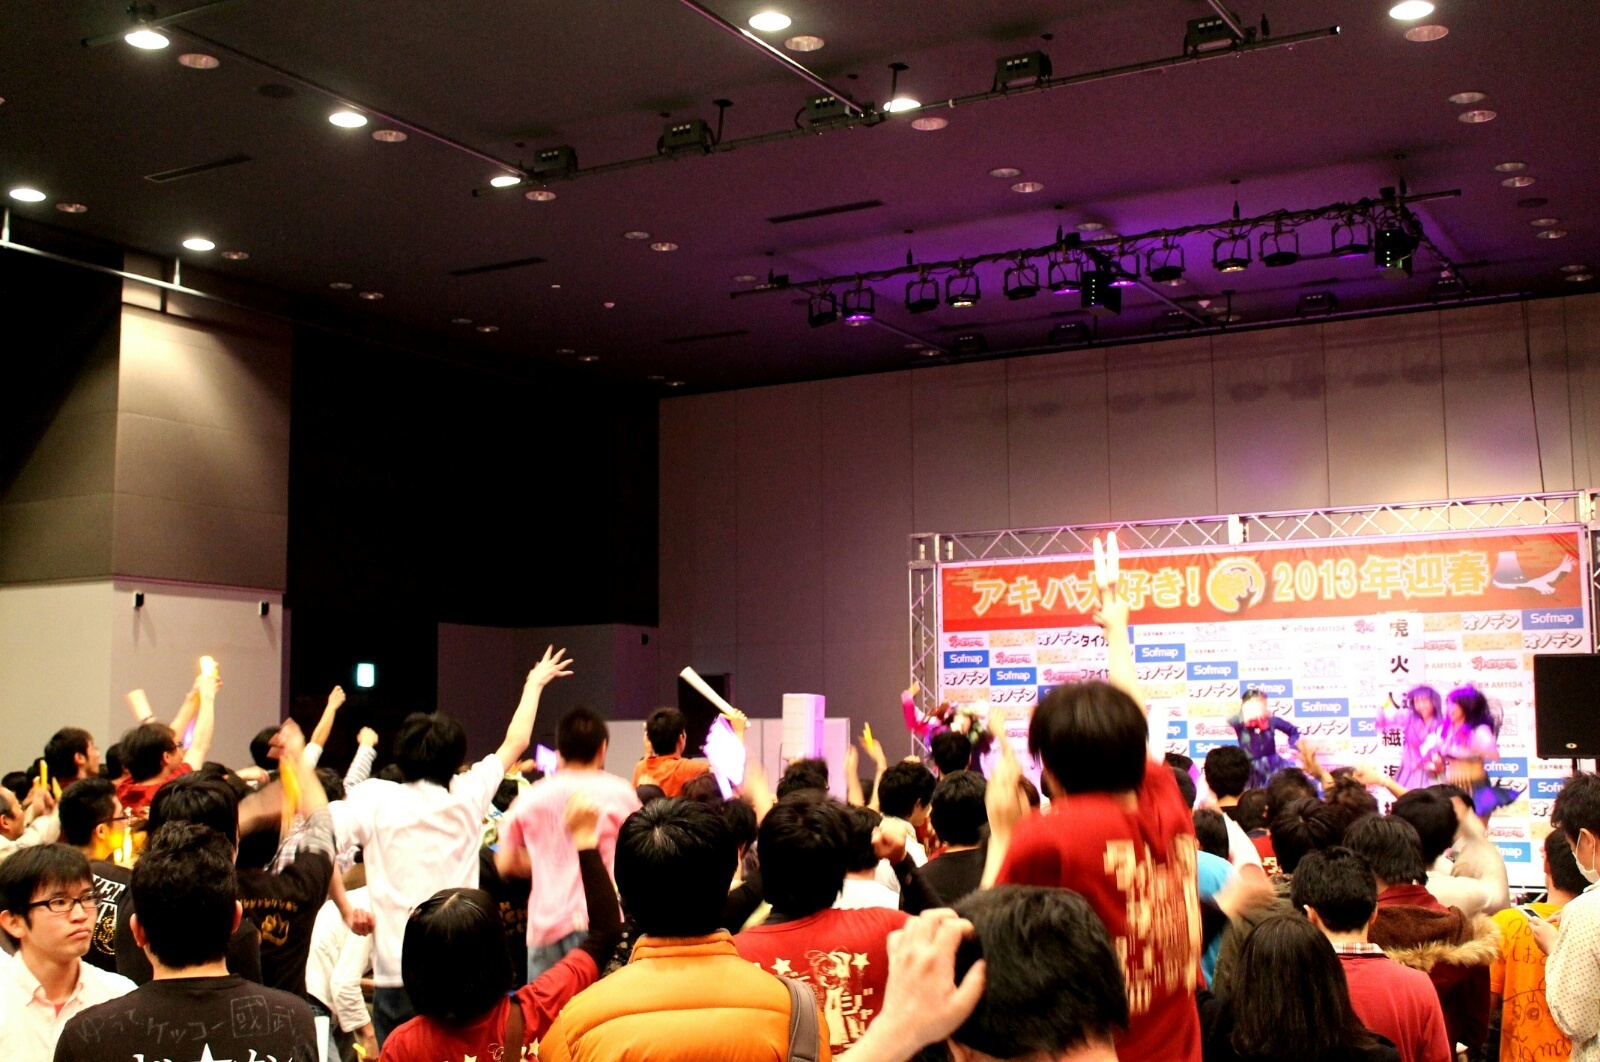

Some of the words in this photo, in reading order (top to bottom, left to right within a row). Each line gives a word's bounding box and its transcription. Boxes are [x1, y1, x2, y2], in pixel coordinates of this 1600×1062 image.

[1273, 551, 1489, 602] 2013年迎春
[1462, 613, 1519, 630] オノデン
[1530, 612, 1574, 624] Sofmap
[1037, 630, 1079, 646] オノデン
[1523, 631, 1583, 649] オノデン
[950, 654, 983, 665] Sofmap
[1142, 647, 1179, 658] Sofmap
[1136, 664, 1185, 680] オノデン
[1193, 665, 1232, 676] Sofmap
[1391, 655, 1410, 674] 火
[943, 670, 988, 686] オノデン
[996, 671, 1030, 682] Sofmap
[1188, 682, 1239, 698] オノデン
[1491, 681, 1523, 689] AM1134
[991, 687, 1036, 703] オノデン
[1302, 702, 1341, 714] Sofmap
[1484, 762, 1519, 773] ofmap
